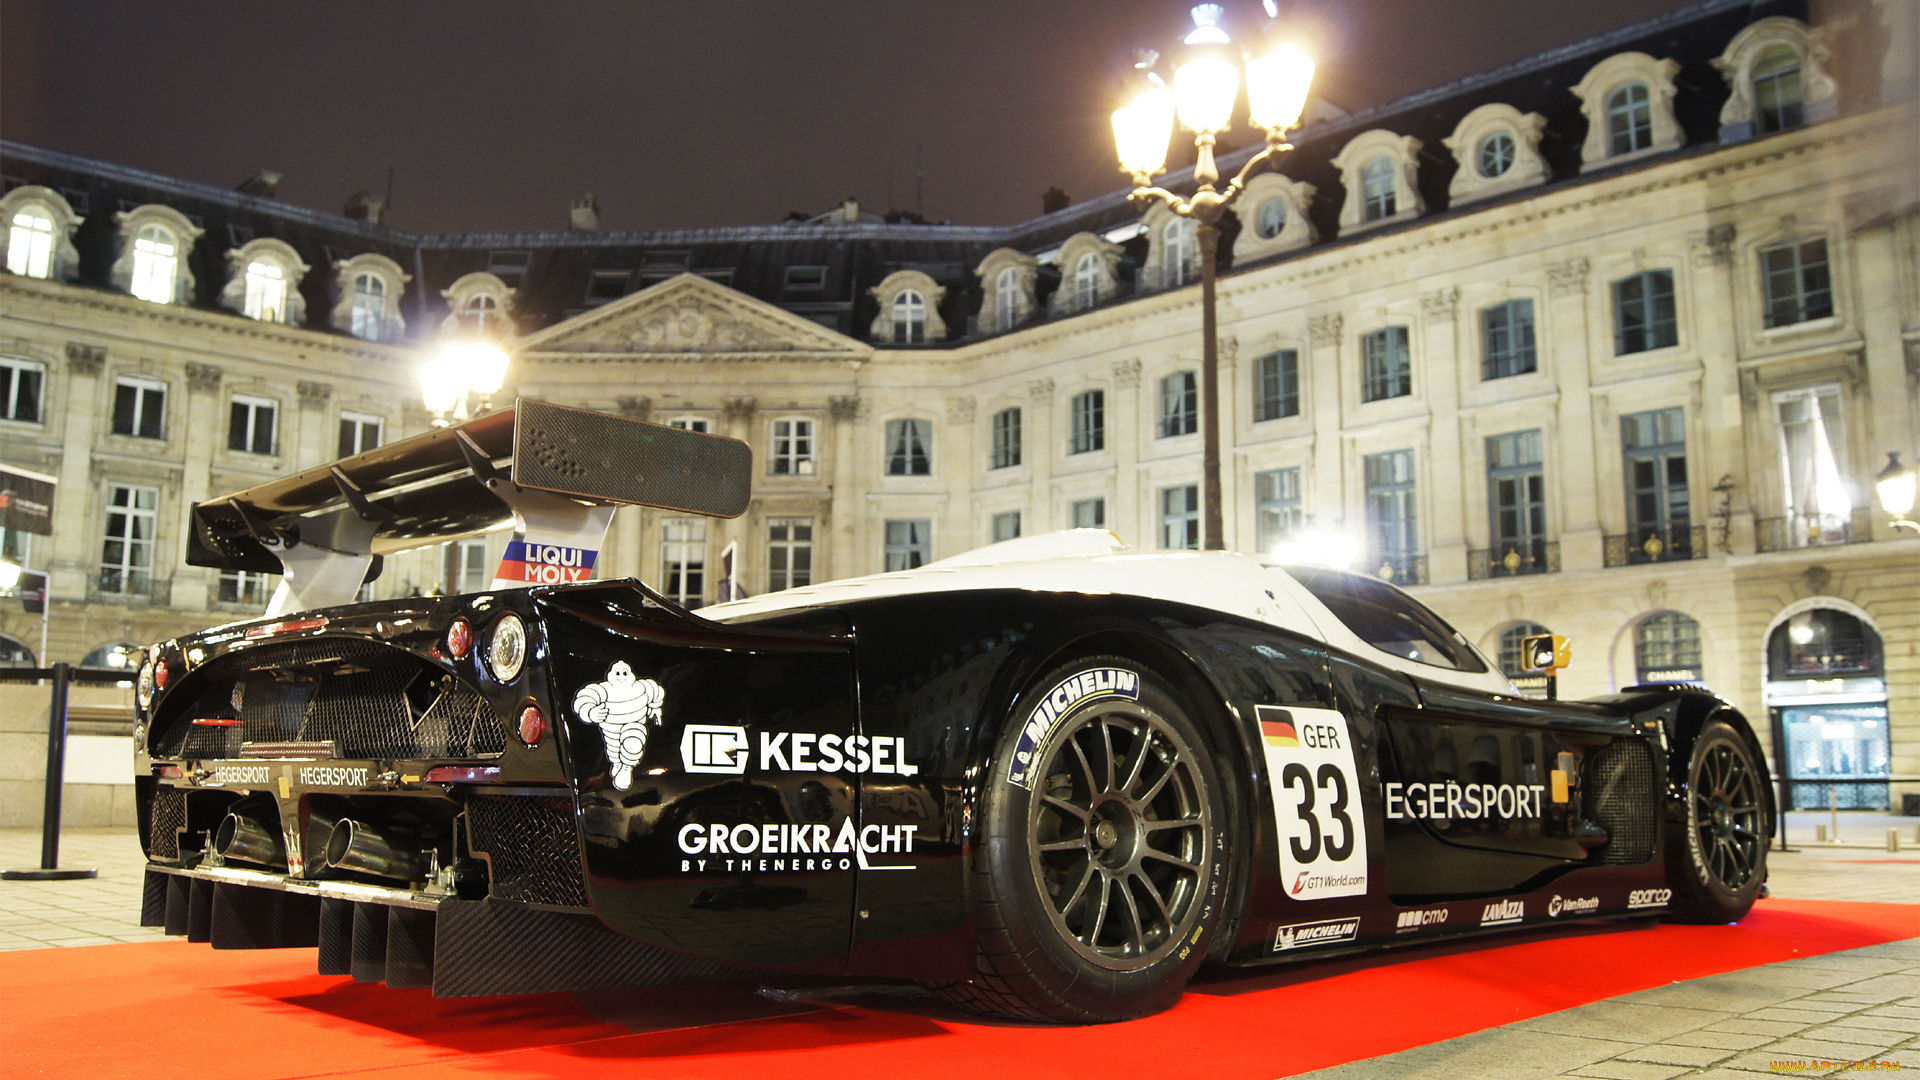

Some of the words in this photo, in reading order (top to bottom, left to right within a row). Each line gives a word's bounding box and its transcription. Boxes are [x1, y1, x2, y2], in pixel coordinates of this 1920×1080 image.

[525, 543, 583, 567] LIQUI
[524, 563, 582, 584] MOLY
[1646, 669, 1696, 682] CHANEL
[1025, 670, 1135, 749] MICHELIN
[1303, 724, 1341, 749] GER
[760, 731, 919, 775] KESSEL
[215, 766, 270, 783] HEGERSPORT
[300, 767, 368, 786] HEGERSPORT
[1380, 782, 1545, 819] EGERSPORT
[1282, 762, 1355, 865] 33
[678, 816, 918, 855] GROEIKRACHT
[681, 859, 707, 872] BY
[726, 858, 851, 872] THENERGO
[1629, 888, 1672, 904] sparco
[1422, 908, 1449, 925] cmo
[1481, 899, 1525, 921] LAVAZZA
[1295, 923, 1356, 941] MICHELIN
